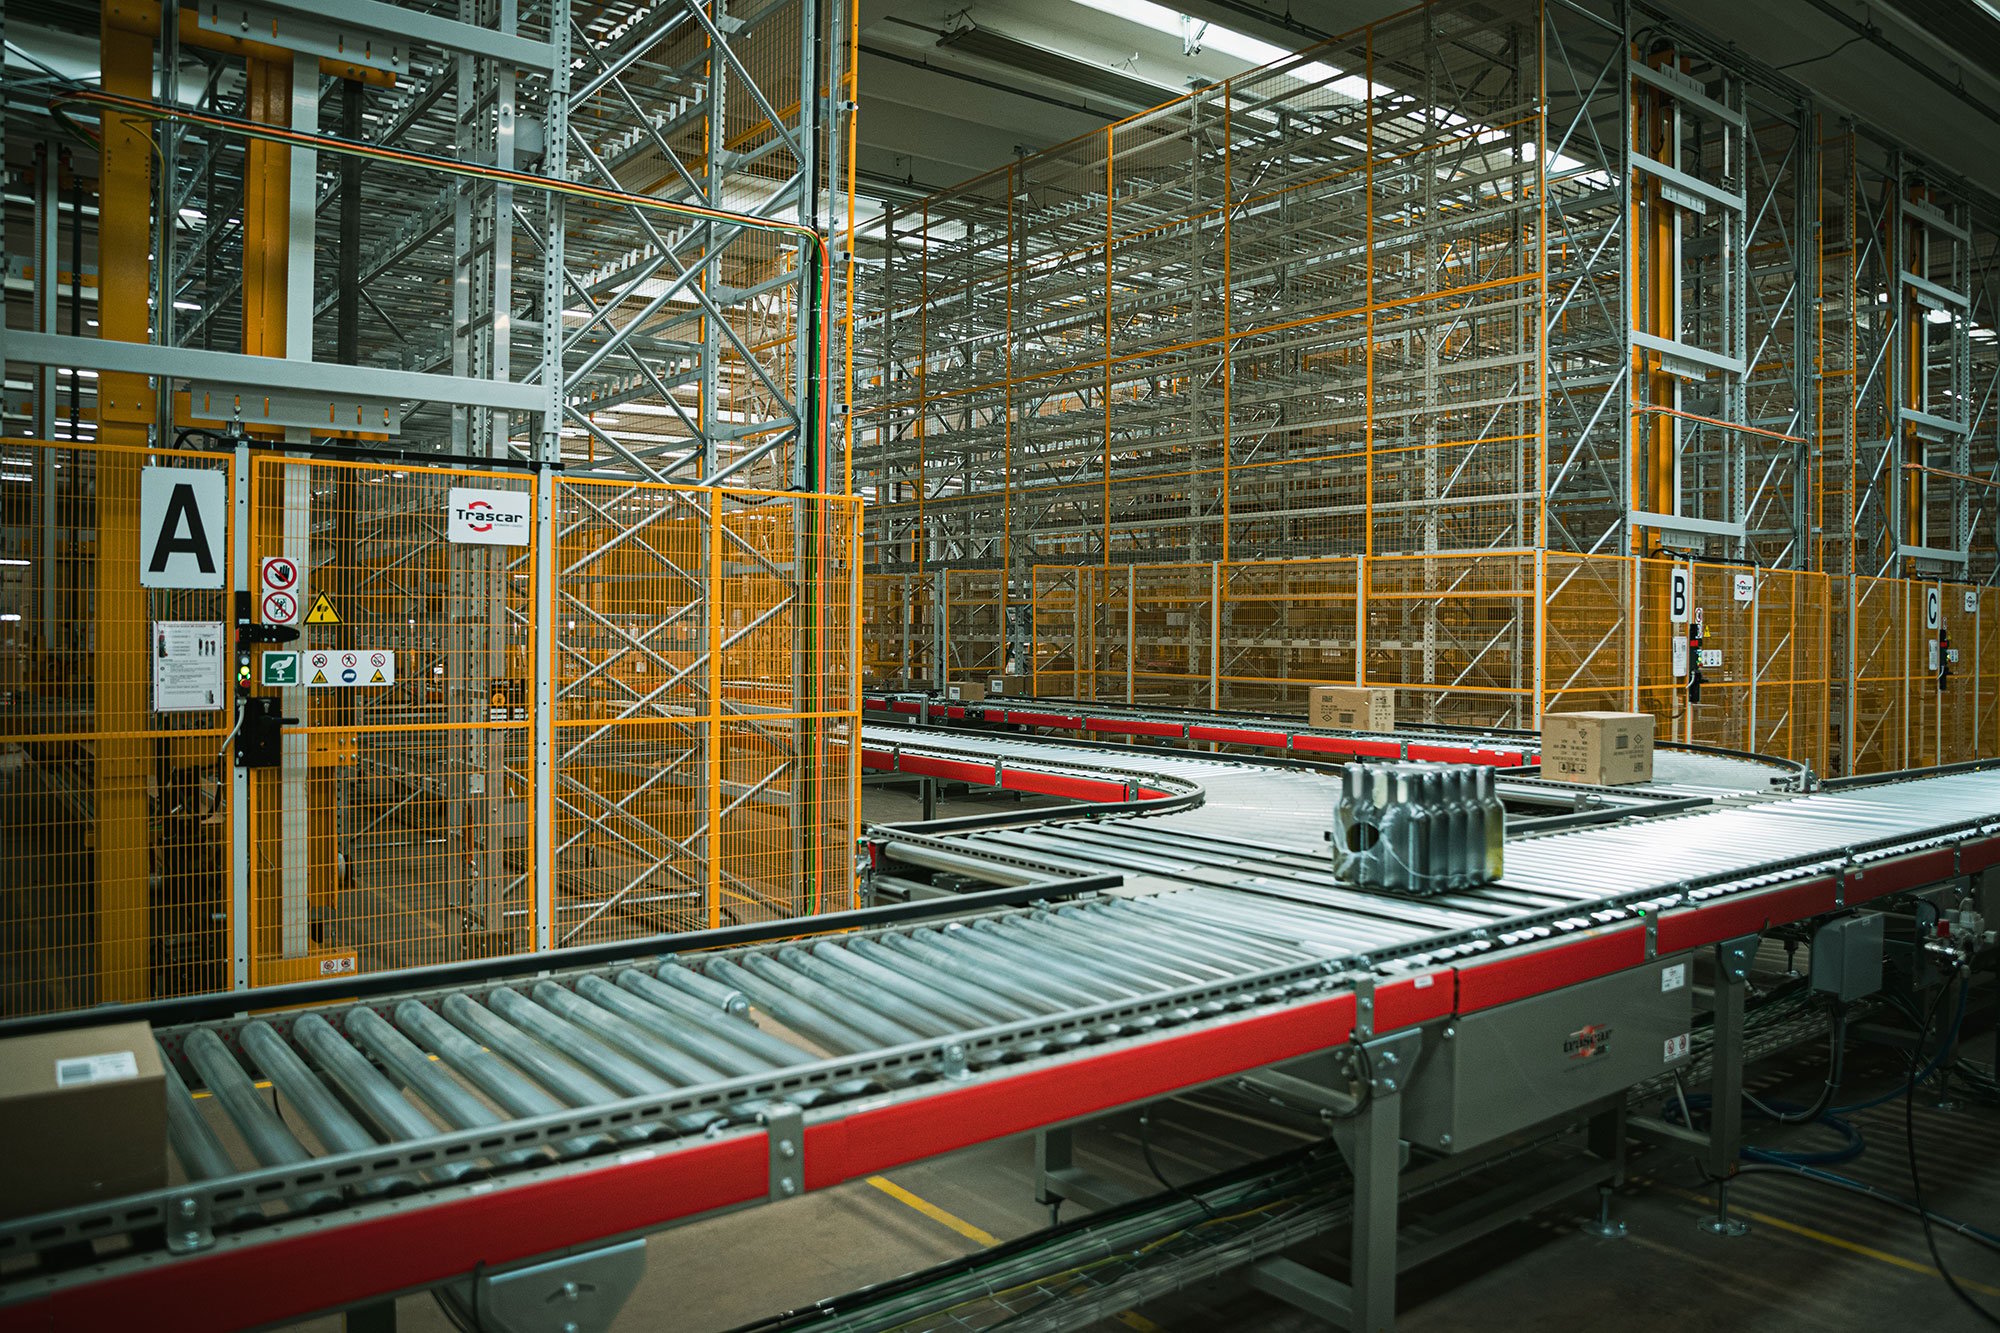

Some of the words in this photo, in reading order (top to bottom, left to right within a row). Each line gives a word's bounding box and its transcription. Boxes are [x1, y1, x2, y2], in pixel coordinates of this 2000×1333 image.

[148, 483, 216, 574] A
[456, 508, 523, 523] Trascar
[1674, 576, 1686, 615] B
[1928, 592, 1937, 624] C
